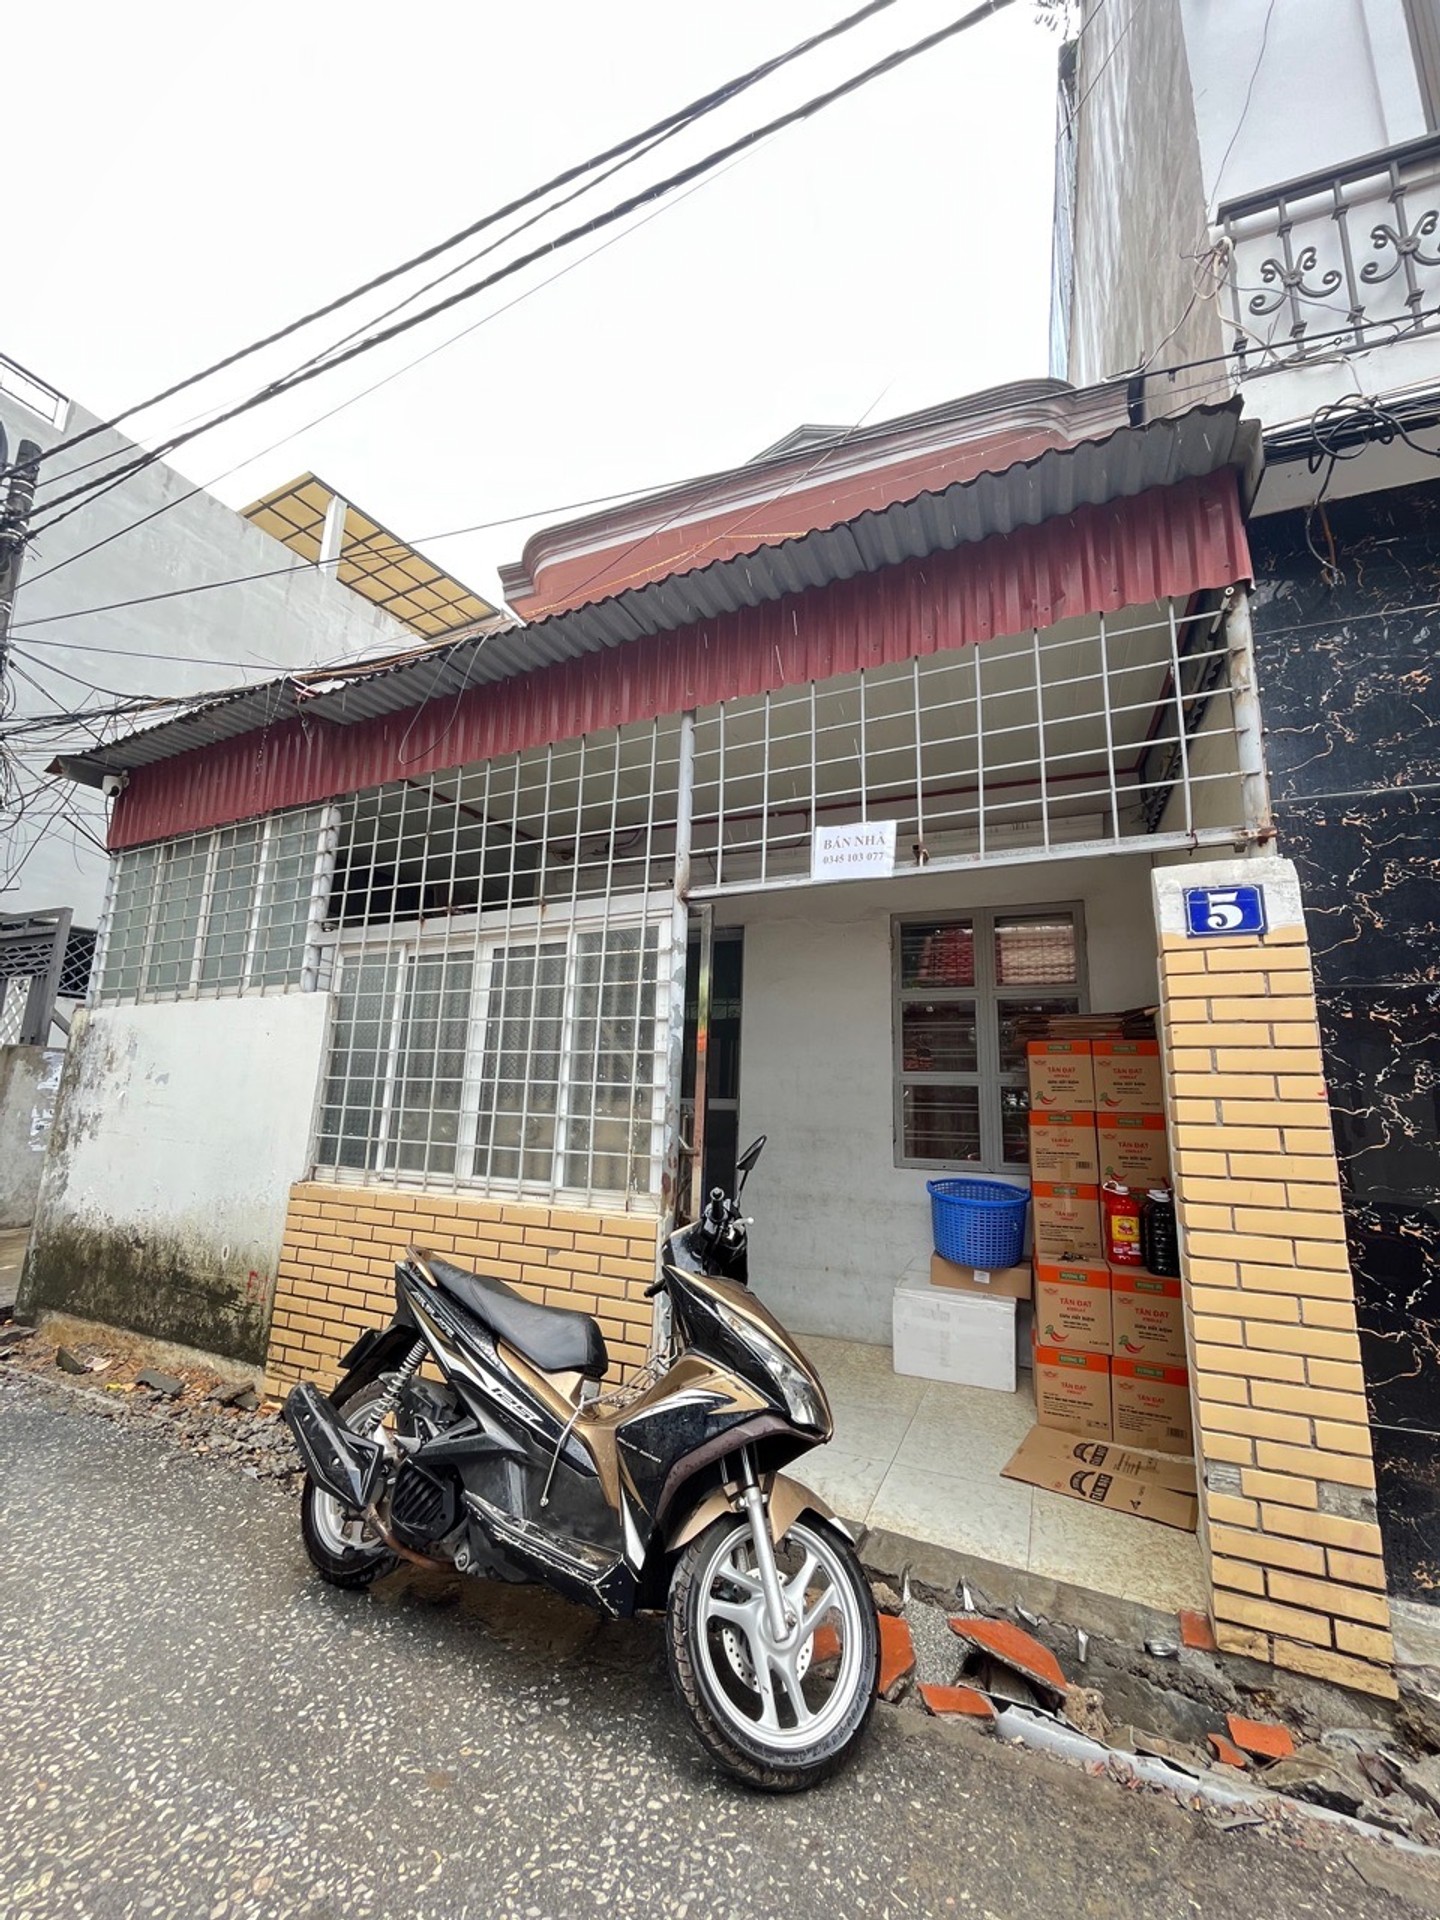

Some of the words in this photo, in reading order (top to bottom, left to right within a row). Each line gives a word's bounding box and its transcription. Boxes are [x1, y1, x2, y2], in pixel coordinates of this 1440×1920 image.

[823, 835, 851, 850] BÁN
[854, 831, 886, 846] NHÀ
[823, 853, 845, 865] 0345
[847, 852, 864, 863] 103
[866, 851, 884, 861] 077
[1207, 891, 1244, 930] 5
